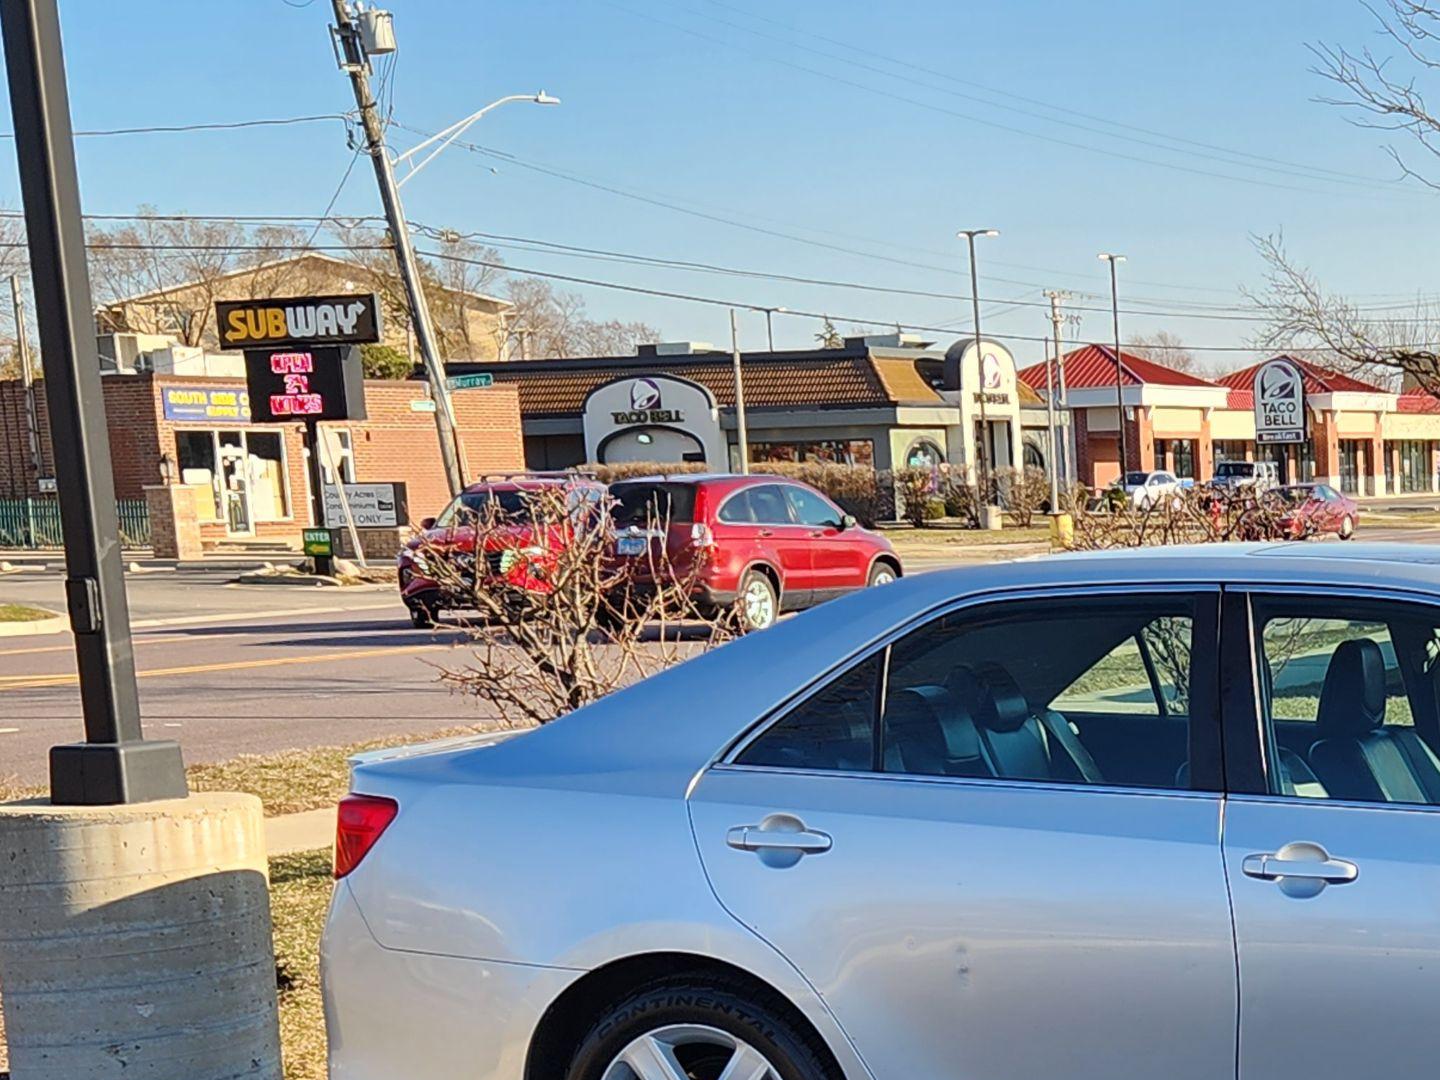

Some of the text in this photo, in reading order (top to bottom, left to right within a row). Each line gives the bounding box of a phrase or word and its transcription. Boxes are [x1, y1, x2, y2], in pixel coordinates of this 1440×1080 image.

[225, 301, 366, 342] SUBWAY
[168, 390, 207, 405] SOUTH
[1261, 402, 1296, 414] TACO
[611, 410, 684, 424] TACO BELL
[1264, 414, 1297, 427] BELL
[358, 514, 382, 524] ONLY
[303, 532, 330, 542] ENTER
[600, 995, 777, 1040] CONTINENTAL
